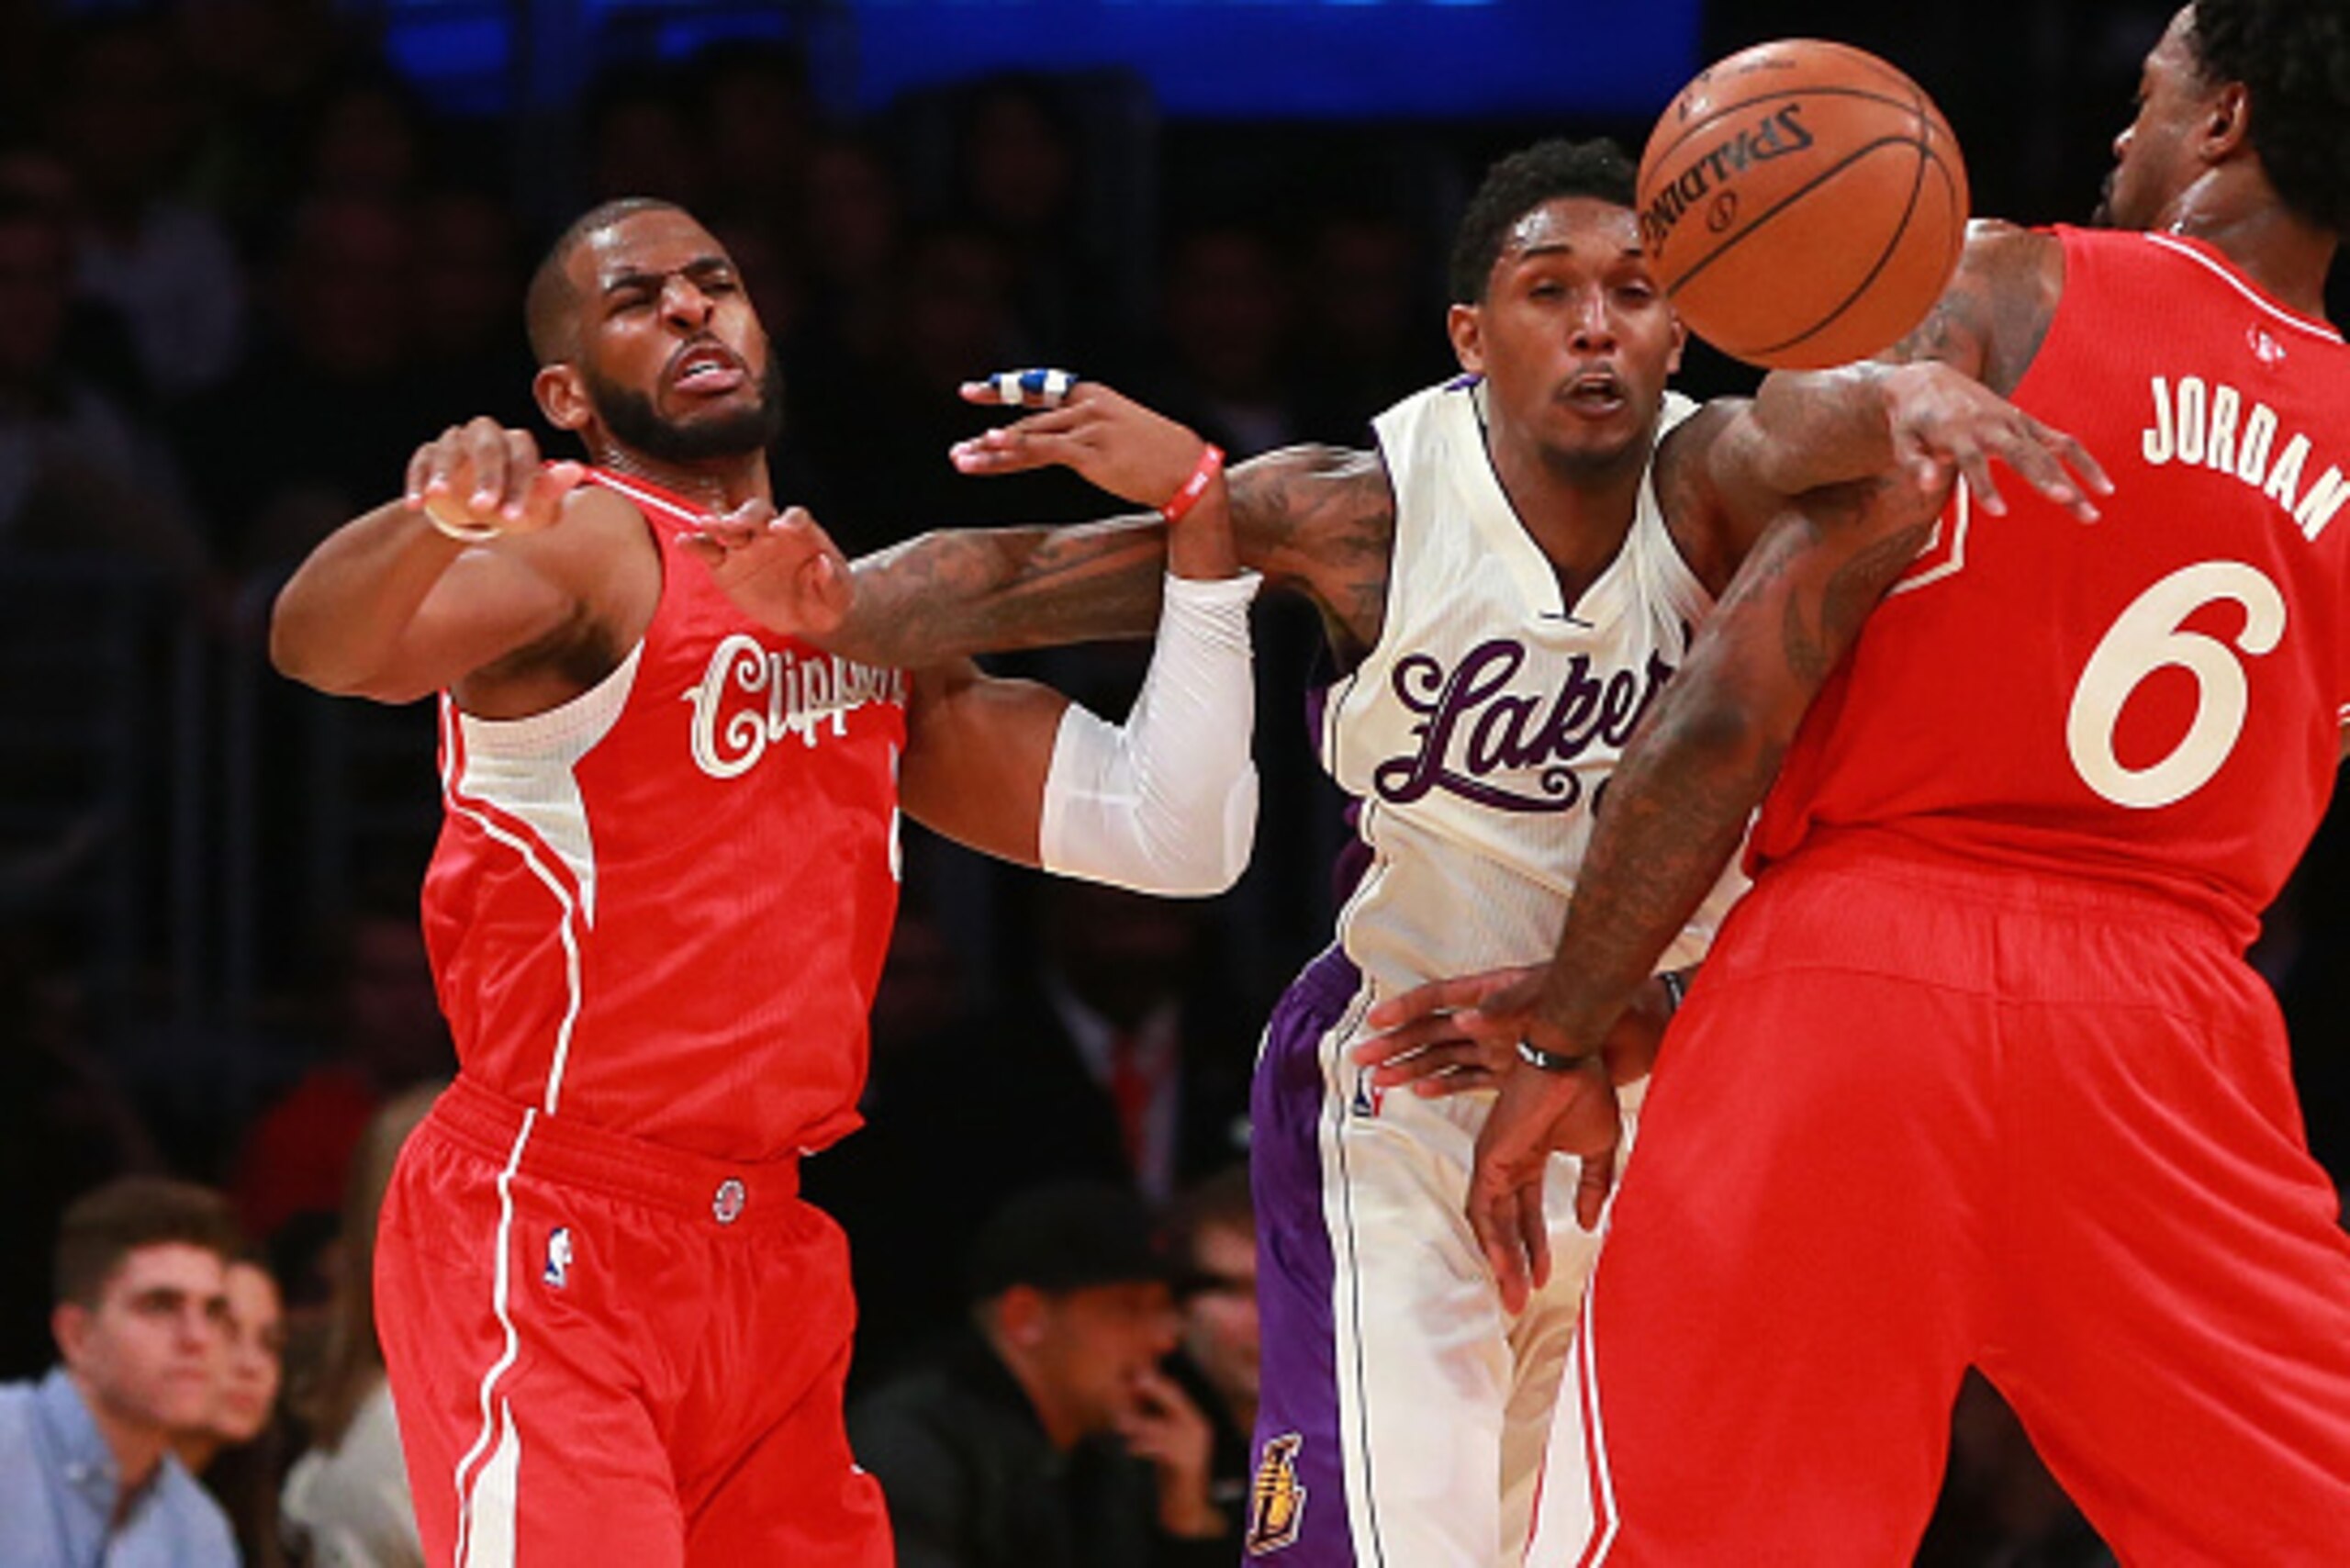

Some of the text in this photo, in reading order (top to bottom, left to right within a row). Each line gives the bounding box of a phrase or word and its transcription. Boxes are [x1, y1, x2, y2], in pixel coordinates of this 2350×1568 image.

[1639, 103, 1813, 259] SPALDING
[2143, 375, 2350, 543] JORDAN
[1374, 620, 1693, 812] Laker
[2065, 559, 2287, 810] 6
